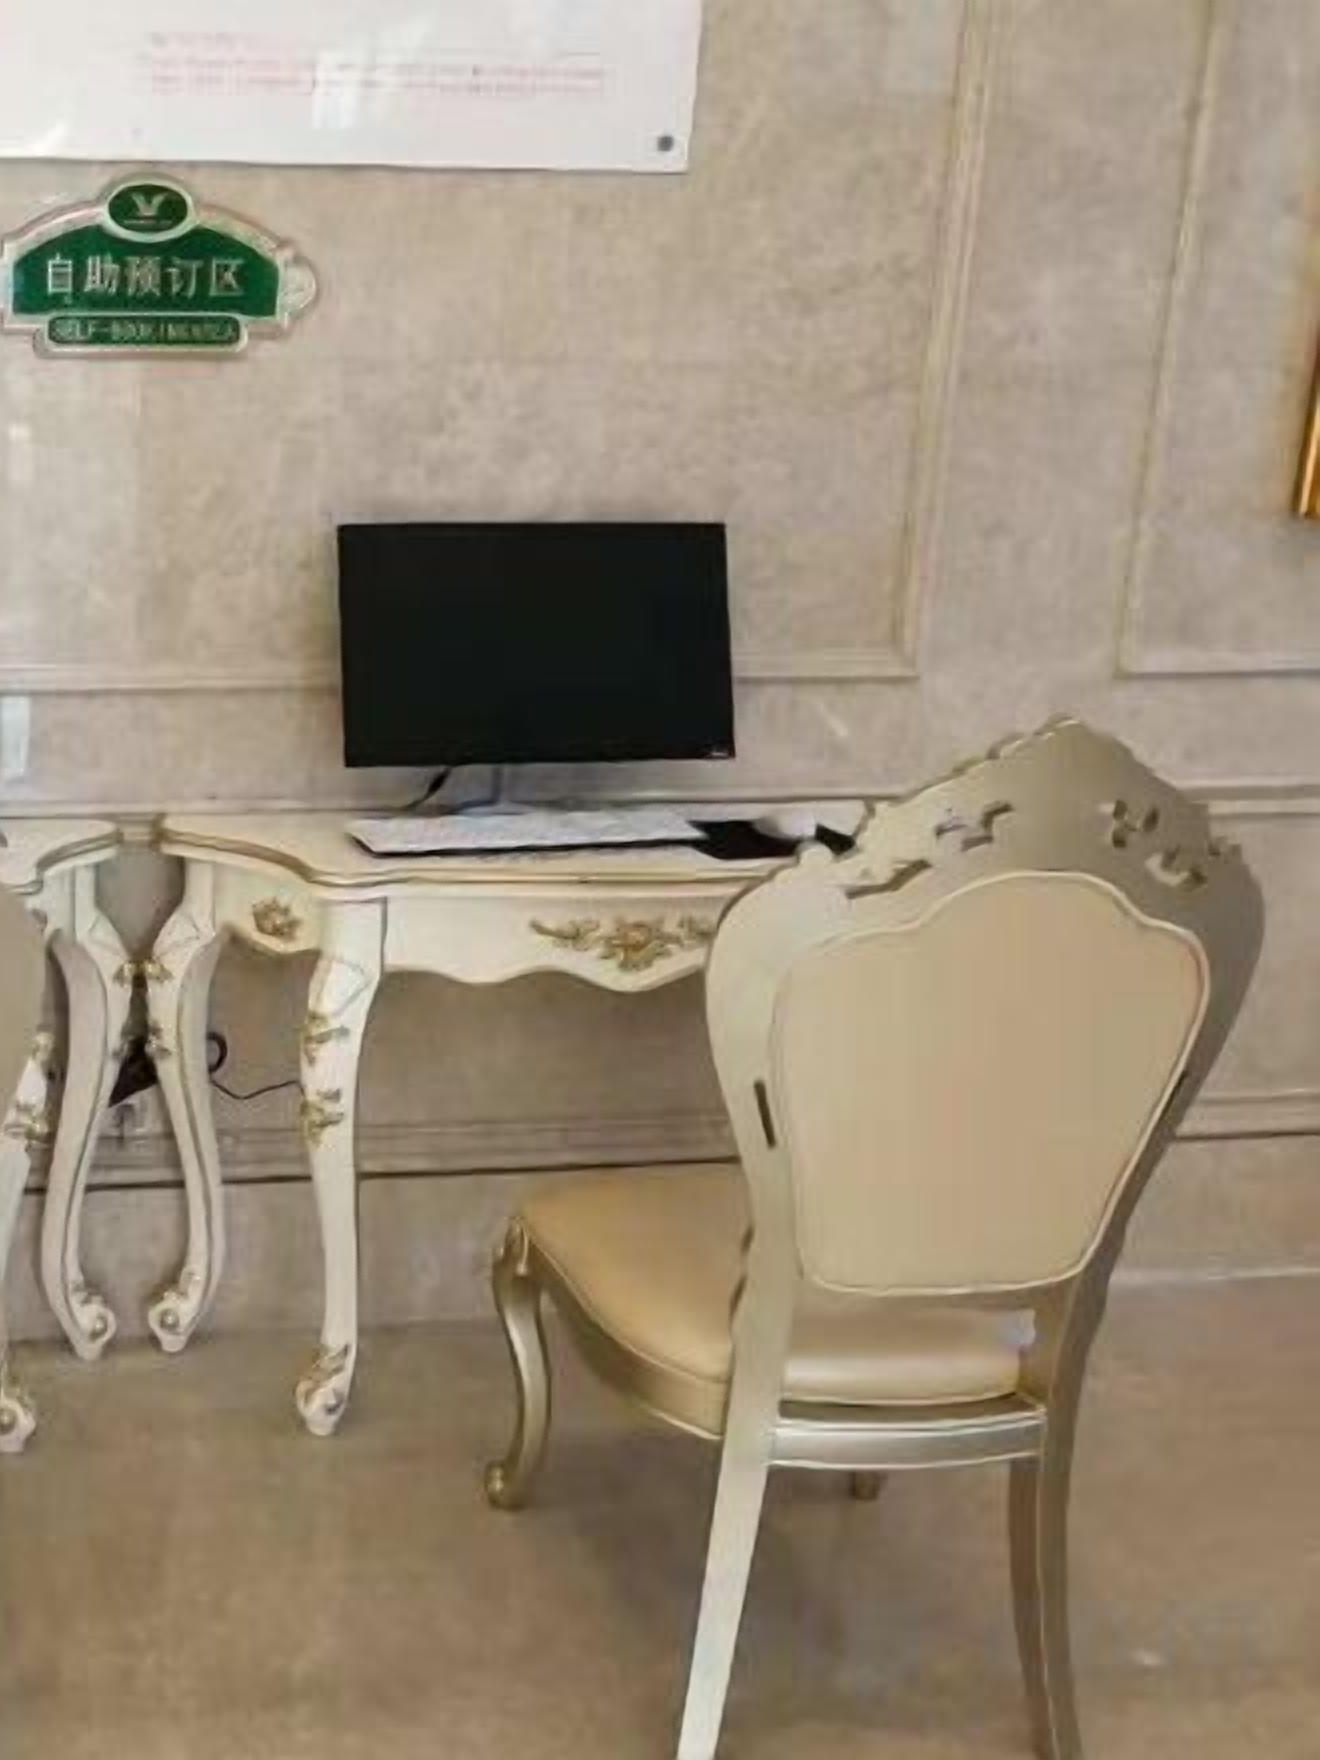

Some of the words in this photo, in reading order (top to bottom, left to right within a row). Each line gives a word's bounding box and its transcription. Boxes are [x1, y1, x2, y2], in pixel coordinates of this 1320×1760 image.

[47, 253, 245, 299] 自助预订区
